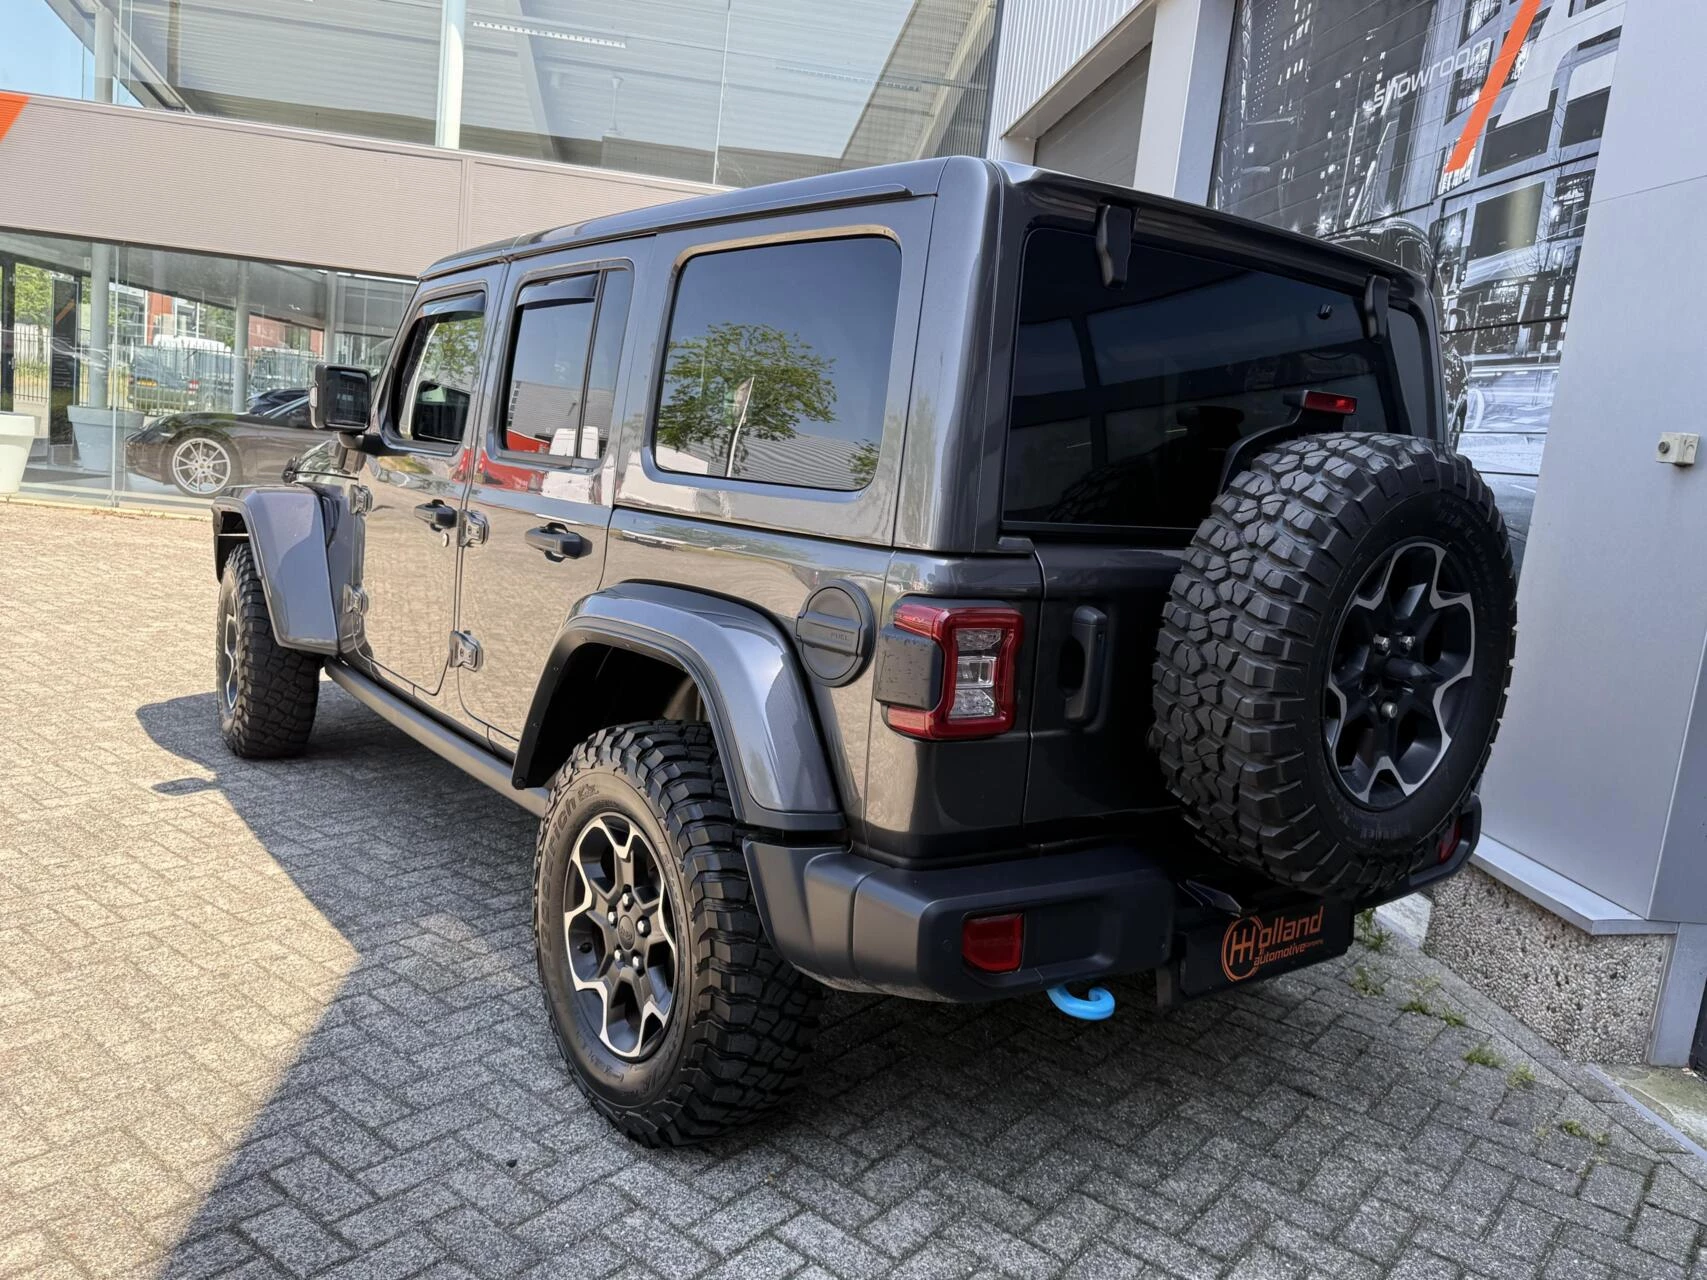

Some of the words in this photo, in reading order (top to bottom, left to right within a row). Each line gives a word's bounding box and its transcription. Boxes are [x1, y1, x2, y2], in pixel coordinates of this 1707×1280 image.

[1373, 37, 1492, 110] showroom
[1227, 905, 1324, 968] Holland
[1253, 942, 1306, 967] automotive
